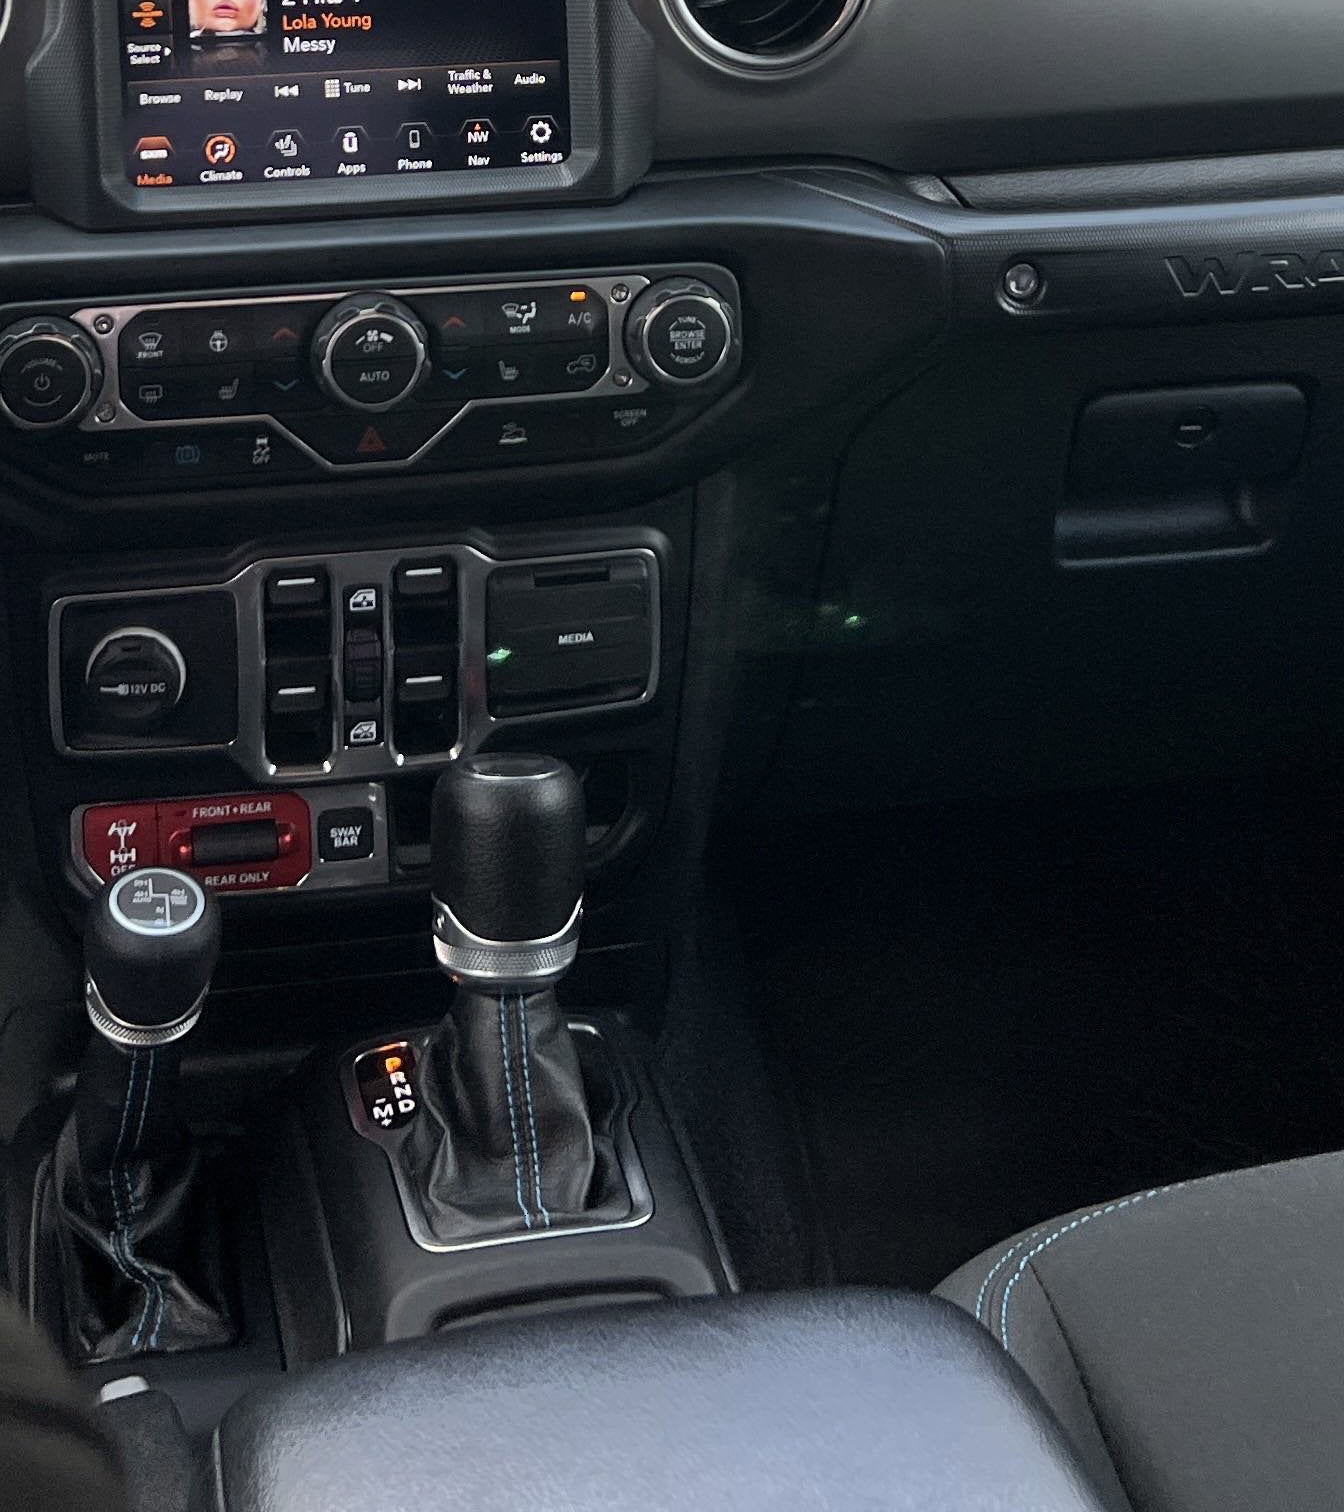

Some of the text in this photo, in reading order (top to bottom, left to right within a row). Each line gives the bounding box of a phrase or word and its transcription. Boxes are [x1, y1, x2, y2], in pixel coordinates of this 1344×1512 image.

[282, 12, 373, 31] Lola Young
[127, 42, 162, 55] Source
[283, 36, 336, 55] Messy
[129, 54, 161, 66] Select
[447, 68, 492, 82] Traffic &
[513, 72, 546, 86] Audio
[343, 81, 371, 94] Tune
[447, 81, 494, 95] Weather
[139, 92, 182, 106] Browse
[204, 88, 244, 102] Replay
[467, 130, 490, 144] NW
[397, 158, 433, 171] Phone
[467, 155, 490, 168] Nav
[520, 150, 564, 165] Settings
[199, 169, 244, 183] Climate
[264, 164, 312, 179] Controls
[337, 162, 367, 176] Apps
[136, 174, 173, 186] Media
[567, 311, 593, 327] A/C
[669, 329, 705, 340] BROWSE
[362, 342, 384, 353] OFF
[674, 340, 703, 351] ENTER
[359, 370, 391, 383] AUTO
[558, 630, 595, 645] MEDIA
[130, 682, 167, 695] 12V DC
[192, 800, 273, 819] FRONT REAR
[329, 824, 363, 838] SWAY
[334, 835, 359, 848] BAR
[204, 871, 271, 886] REAR ONLY
[390, 1071, 407, 1085] R
[393, 1083, 413, 1099] N
[372, 1103, 394, 1120] M
[398, 1098, 416, 1114] D
